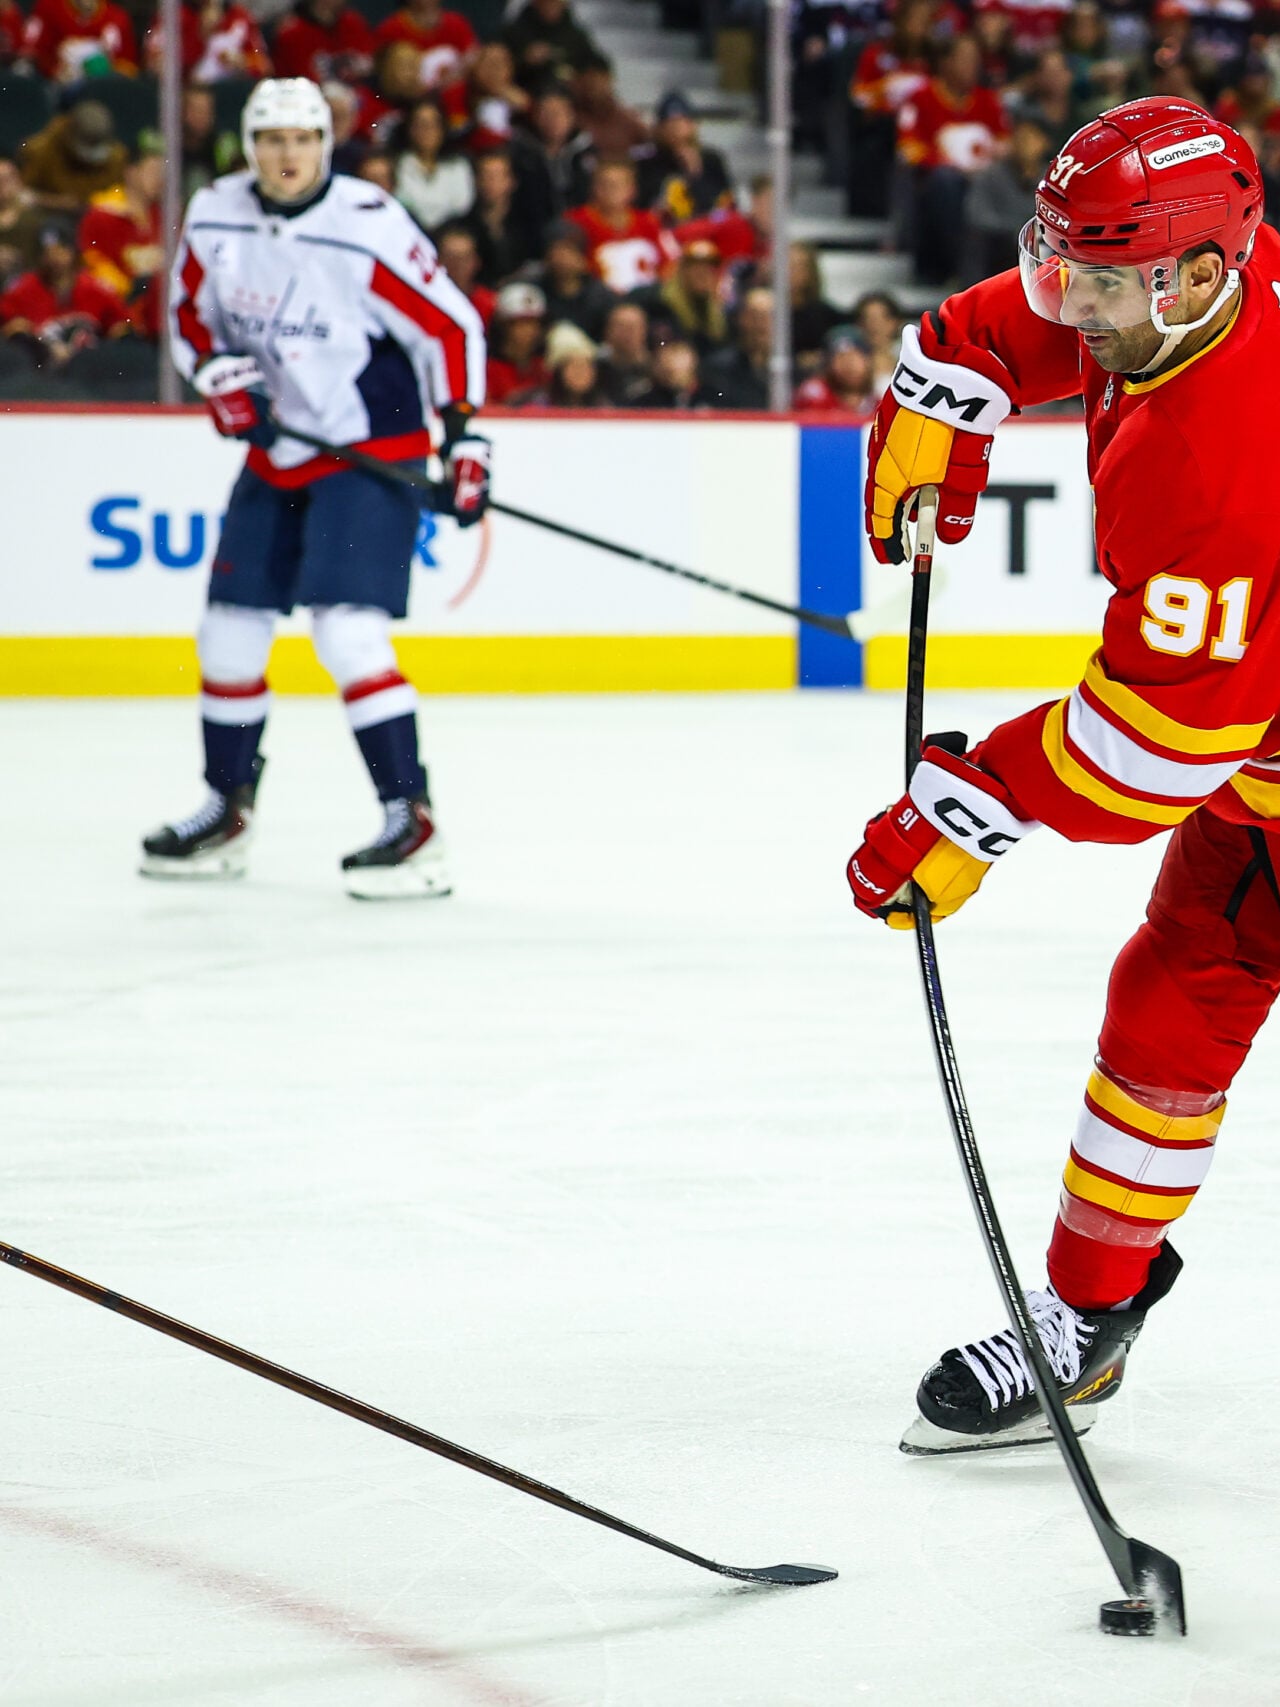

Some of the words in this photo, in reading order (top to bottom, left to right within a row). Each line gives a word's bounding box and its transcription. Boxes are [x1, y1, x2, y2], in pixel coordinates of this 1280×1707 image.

[1050, 154, 1084, 190] 91
[1038, 203, 1070, 230] CCM
[893, 362, 991, 423] CM
[944, 514, 974, 526] CC
[1140, 572, 1254, 664] 91
[897, 807, 919, 832] 91
[934, 796, 1021, 856] CC
[852, 859, 886, 895] CCM
